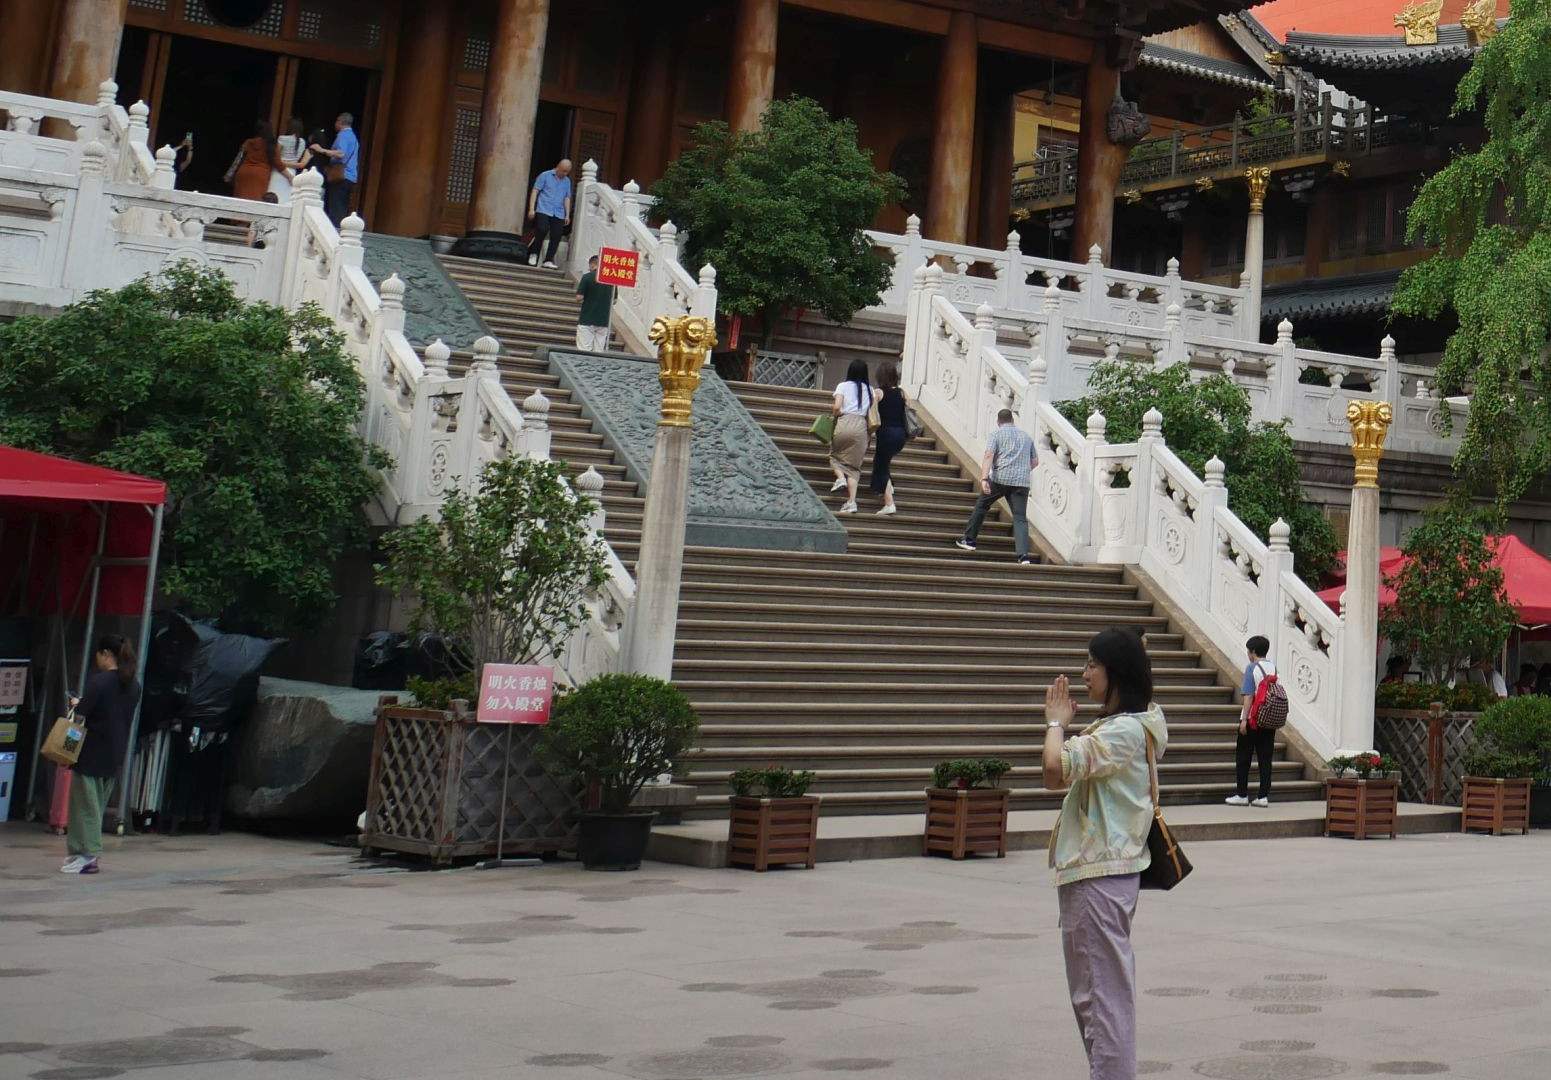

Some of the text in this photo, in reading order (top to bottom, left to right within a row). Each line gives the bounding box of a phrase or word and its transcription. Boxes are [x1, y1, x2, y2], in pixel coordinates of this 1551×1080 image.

[488, 675, 547, 691] 明火香烛
[485, 695, 545, 712] 勿入殿堂
